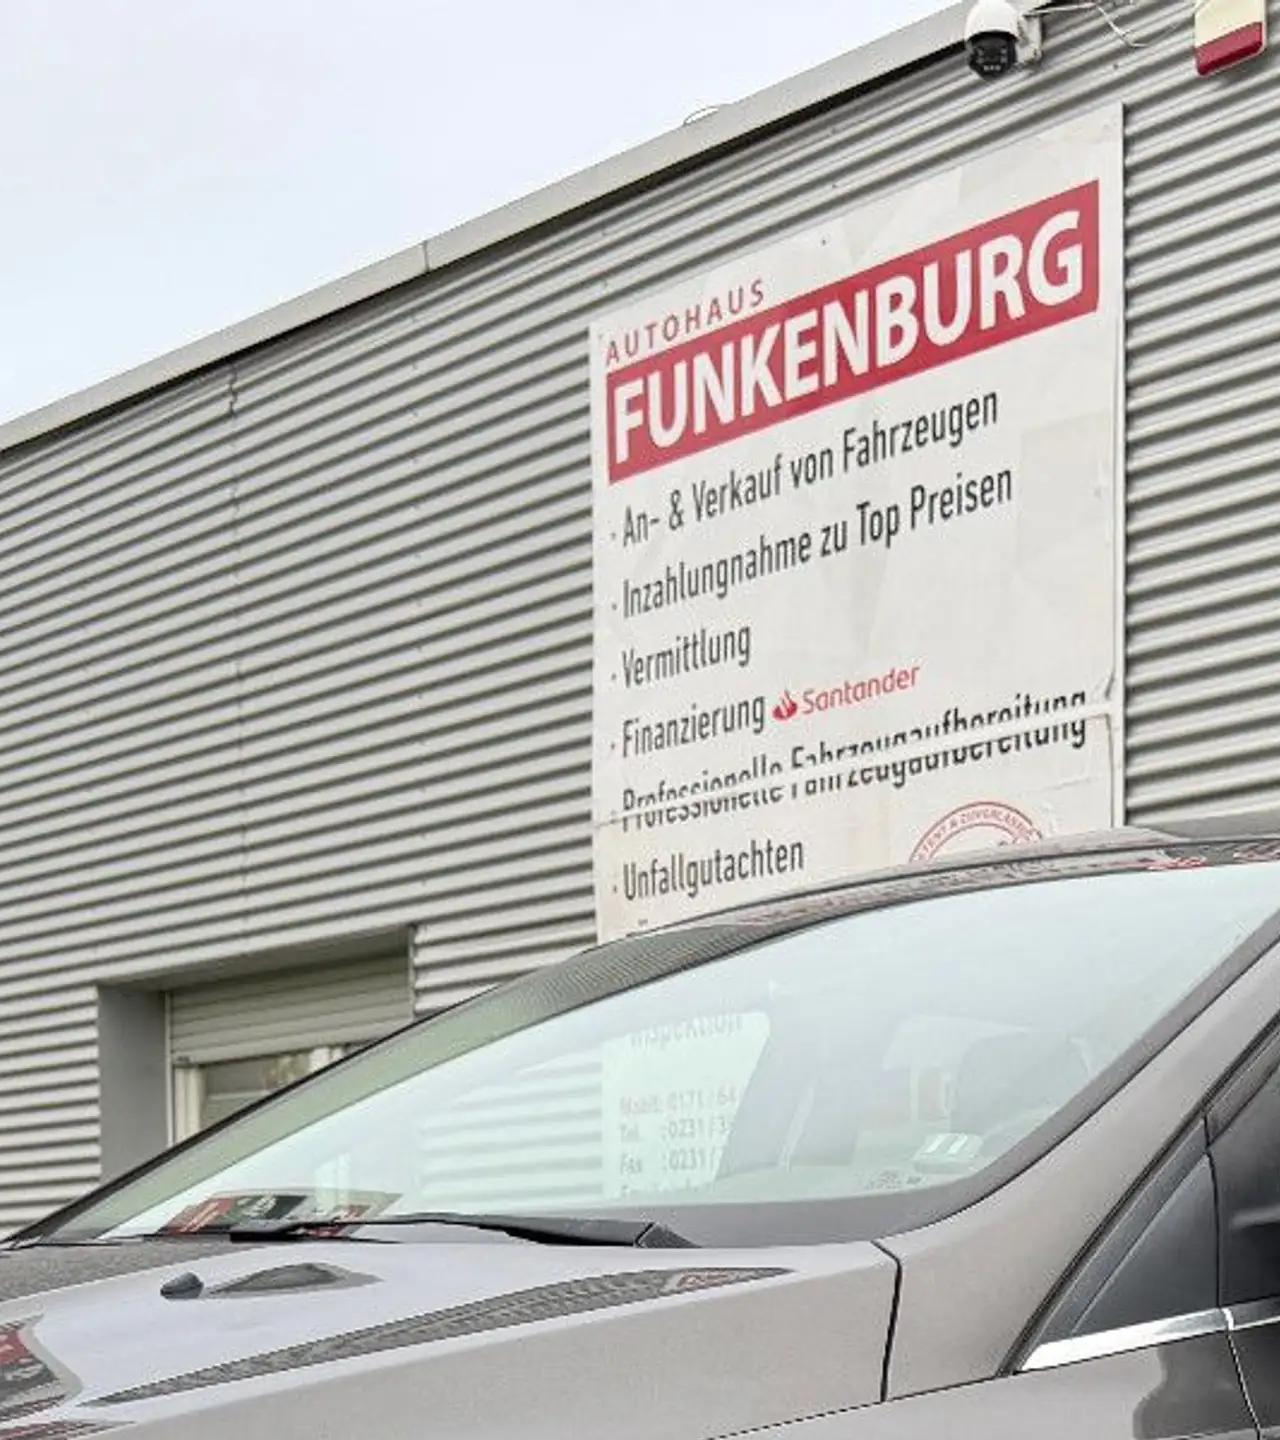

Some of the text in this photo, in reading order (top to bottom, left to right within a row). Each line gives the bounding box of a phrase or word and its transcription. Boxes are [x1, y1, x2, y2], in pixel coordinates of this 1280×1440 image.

[606, 278, 765, 367] AUTOHAUS
[614, 209, 1083, 464] FUNKENBURG
[623, 391, 999, 548] An- & Verkauf von Fahrzeugen
[623, 469, 1012, 620] Inzahlungnahme zu Top Preisen
[622, 624, 752, 688] Vermittlung
[802, 666, 921, 715] Santander
[623, 695, 767, 758] Finanzierung
[624, 842, 805, 901] Unfallgutachten
